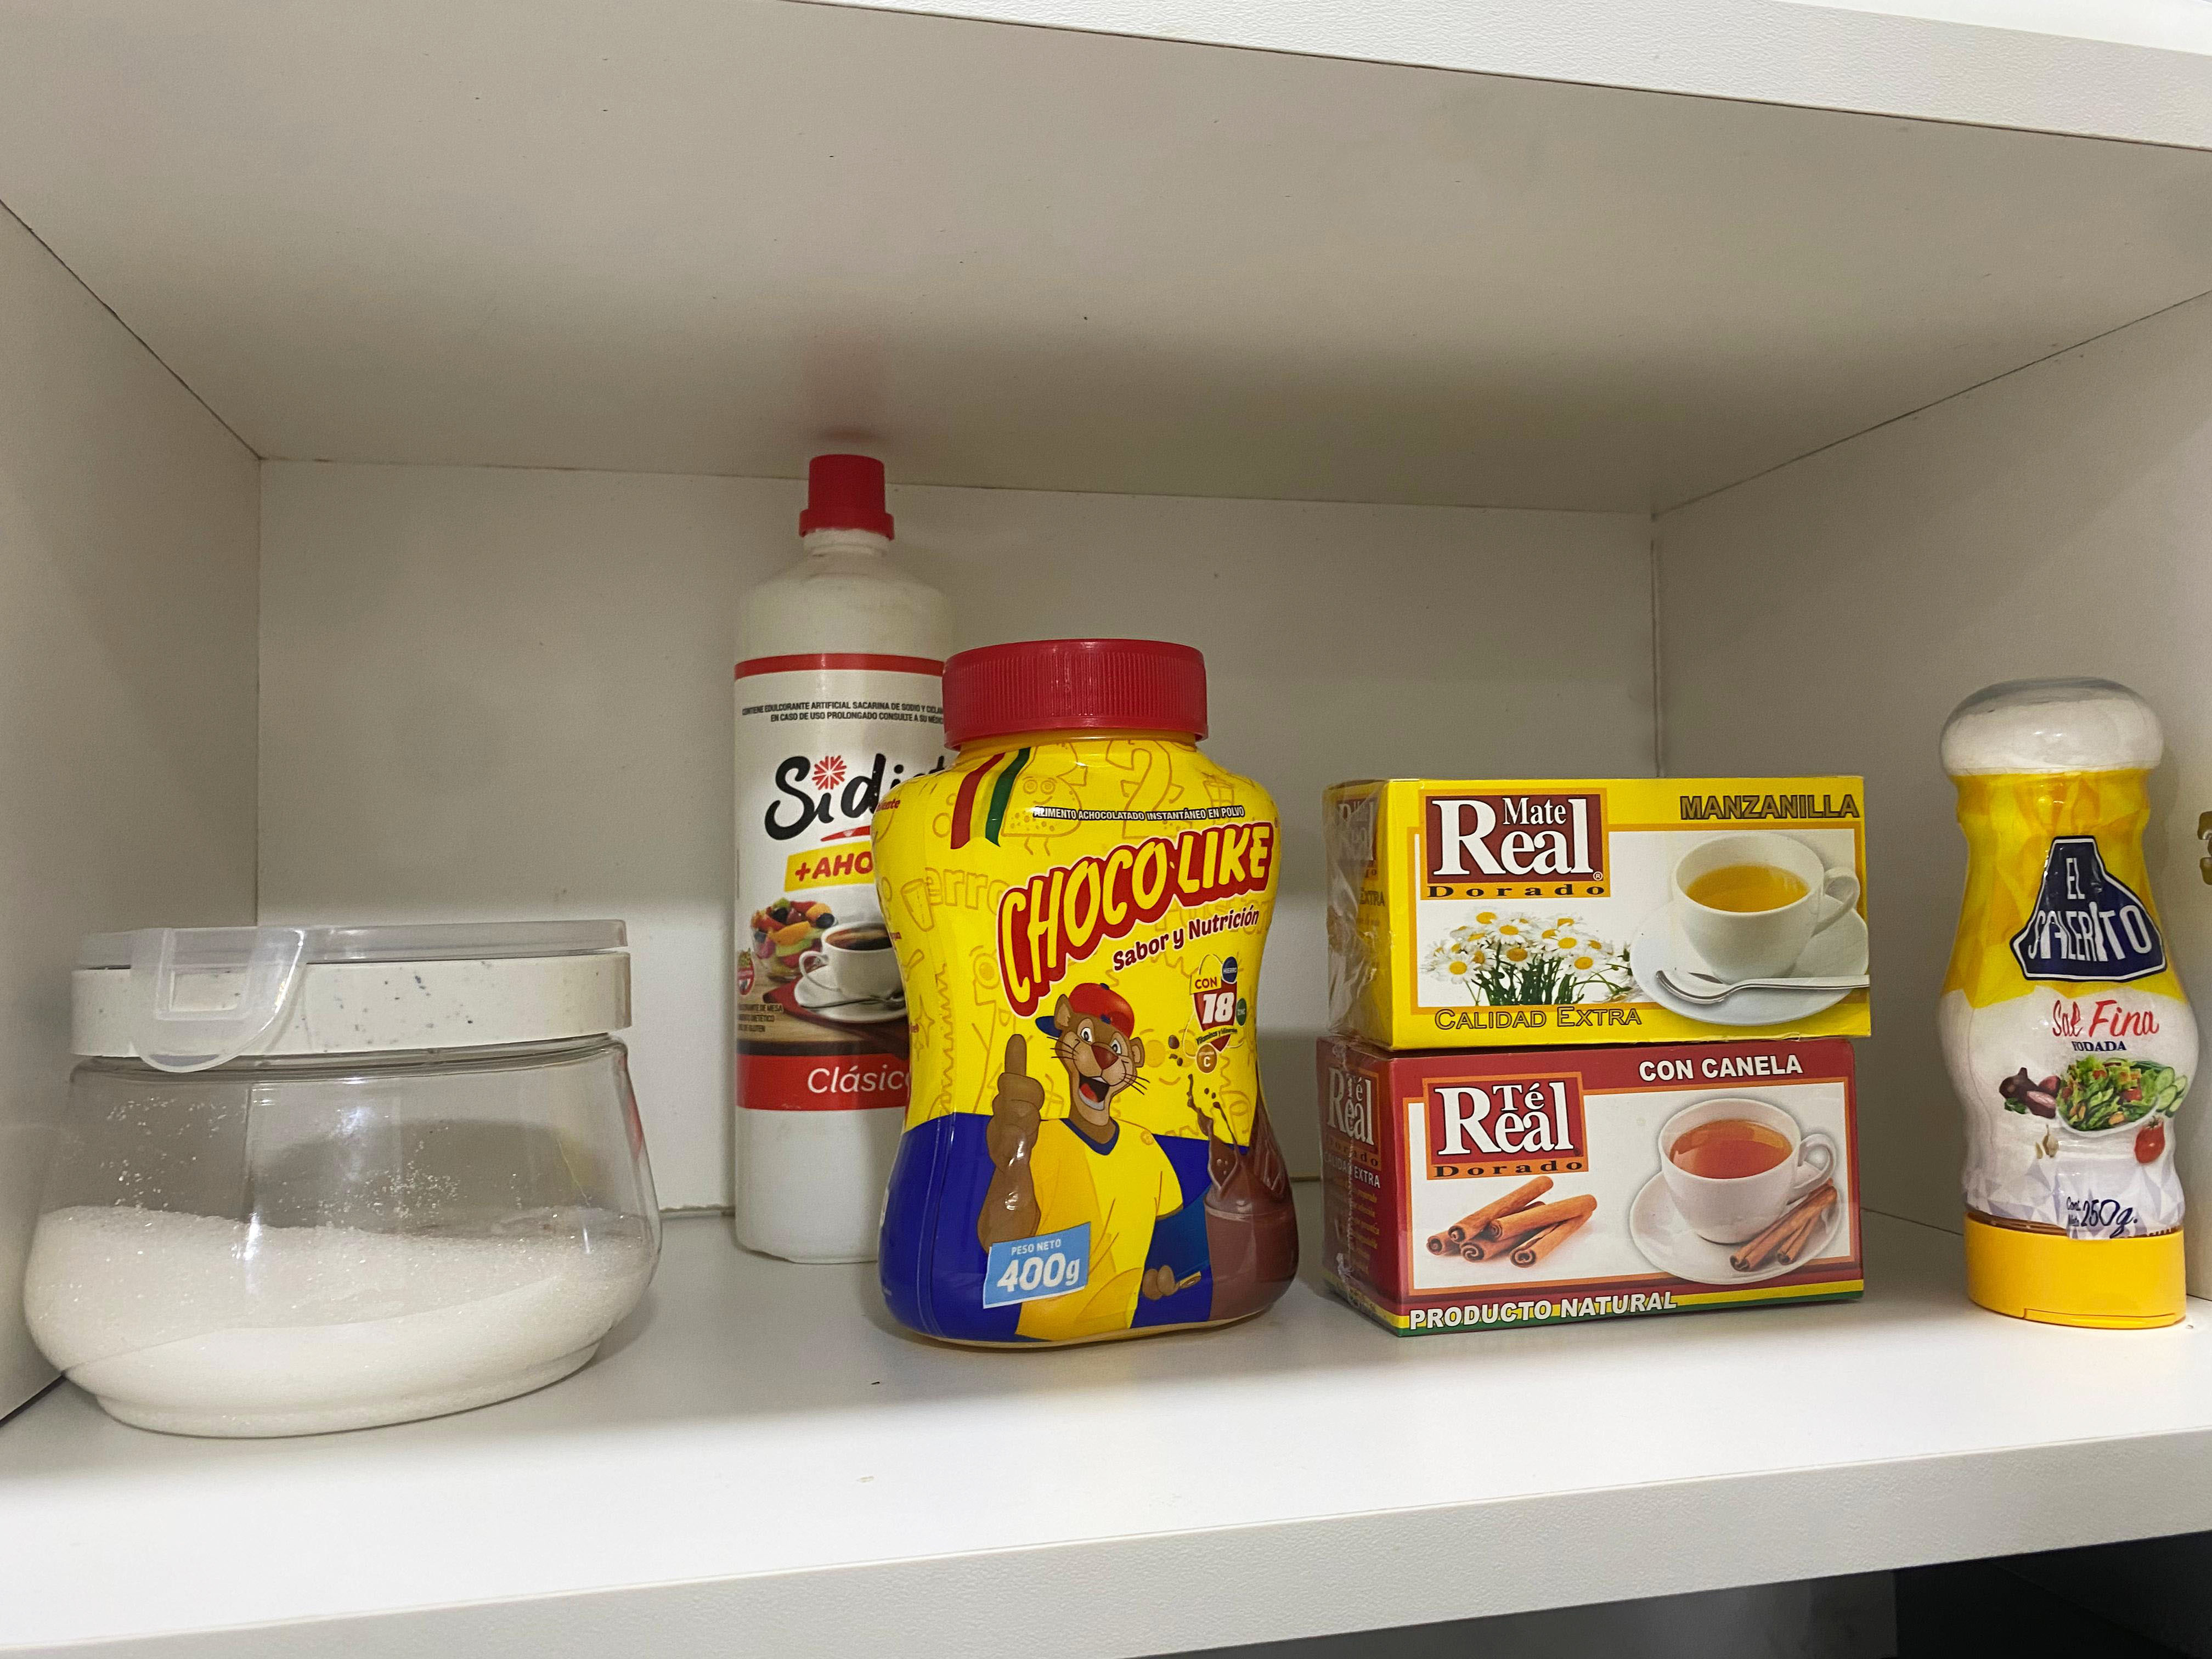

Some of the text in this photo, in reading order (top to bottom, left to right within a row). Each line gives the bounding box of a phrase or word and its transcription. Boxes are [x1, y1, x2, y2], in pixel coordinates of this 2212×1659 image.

[765, 702, 810, 713] EDULCORANTE
[811, 701, 851, 709] ARTIFICIAL
[853, 702, 890, 710] SACARINA
[901, 703, 920, 712] SODIO
[827, 712, 877, 720] PROLONGADO
[879, 712, 913, 721] CONSULTE
[1034, 806, 1245, 820] ALIMENTO ACHOCOLATADO INSTANTÁNEO EN POLVO
[1502, 798, 1567, 825] Mate
[1680, 794, 1860, 820] MANZANILLA
[1432, 798, 1594, 876] Real
[1426, 884, 1605, 898] Dorado
[2067, 857, 2085, 900] EL
[1113, 933, 1170, 971] Sabor
[1173, 928, 1184, 949] y
[1189, 905, 1260, 940] Nutrición
[2028, 901, 2152, 962] SALERITO
[1195, 977, 1217, 989] CON
[1202, 992, 1234, 1024] 18
[2052, 1000, 2159, 1037] Sal Fina
[1639, 1054, 1804, 1082] CON CANELA
[1327, 1067, 1374, 1146] Real
[1492, 1082, 1545, 1112] Té
[1434, 1081, 1574, 1155] Real
[1354, 1165, 1380, 1188] EXTRA
[1434, 1159, 1583, 1178] Dorado
[1011, 1238, 1062, 1256] PESO NETO
[996, 1252, 1080, 1293] 400g
[1409, 1291, 1677, 1330] PRODUCTO NATURAL
